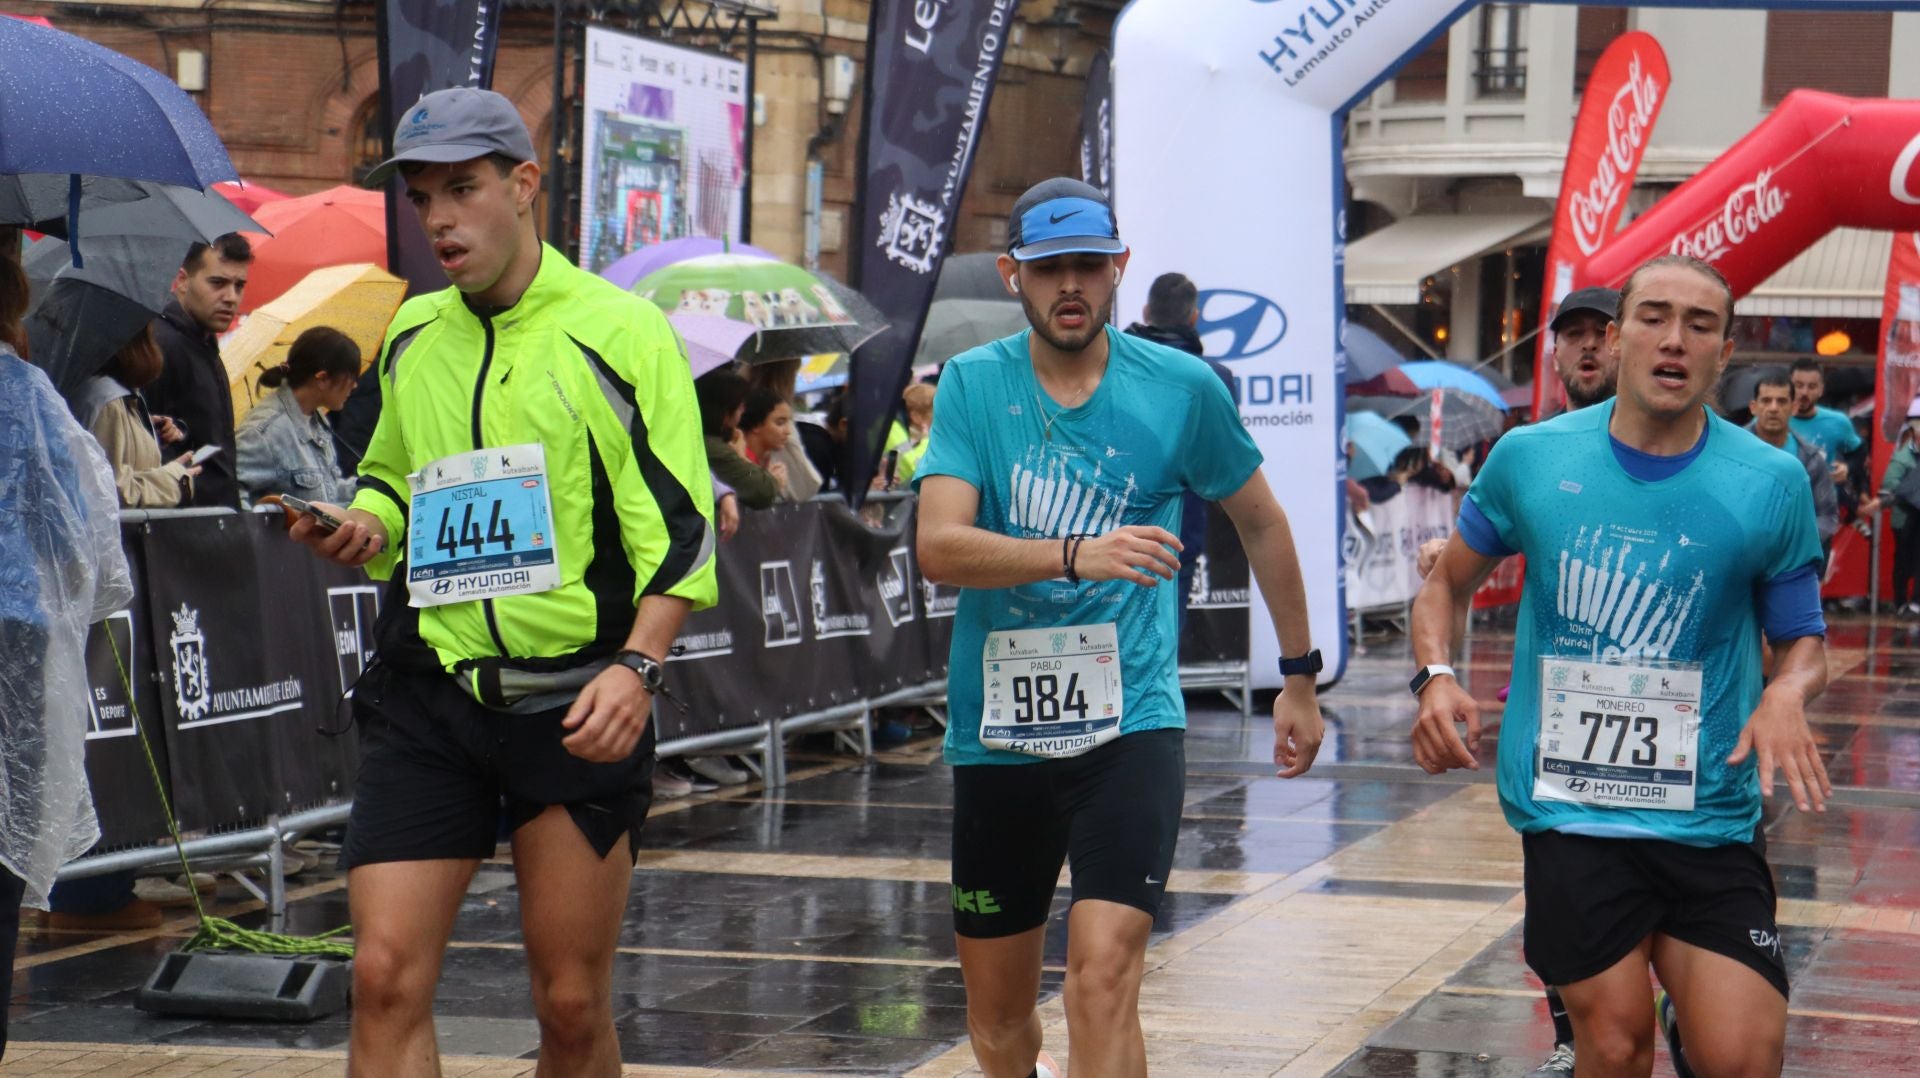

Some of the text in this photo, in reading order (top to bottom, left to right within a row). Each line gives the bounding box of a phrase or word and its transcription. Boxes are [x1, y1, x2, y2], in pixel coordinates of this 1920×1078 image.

[905, 0, 949, 54] Le
[1258, 0, 1356, 74] HYU
[1284, 27, 1352, 87] Lemauto
[941, 33, 999, 207] AYUNTAMIENTO
[451, 487, 488, 502] NISTAL
[436, 499, 515, 559] 444
[458, 570, 531, 591] HYUNDAI
[1211, 590, 1249, 603] AYUNT
[1030, 661, 1062, 672] PABLO
[1013, 673, 1089, 724] 984
[1596, 699, 1645, 713] MONEREO
[1033, 735, 1096, 752] HYUNDAI
[1579, 711, 1659, 767] 773
[1594, 782, 1667, 798] HYUNDAI
[951, 884, 1002, 914] IKE
